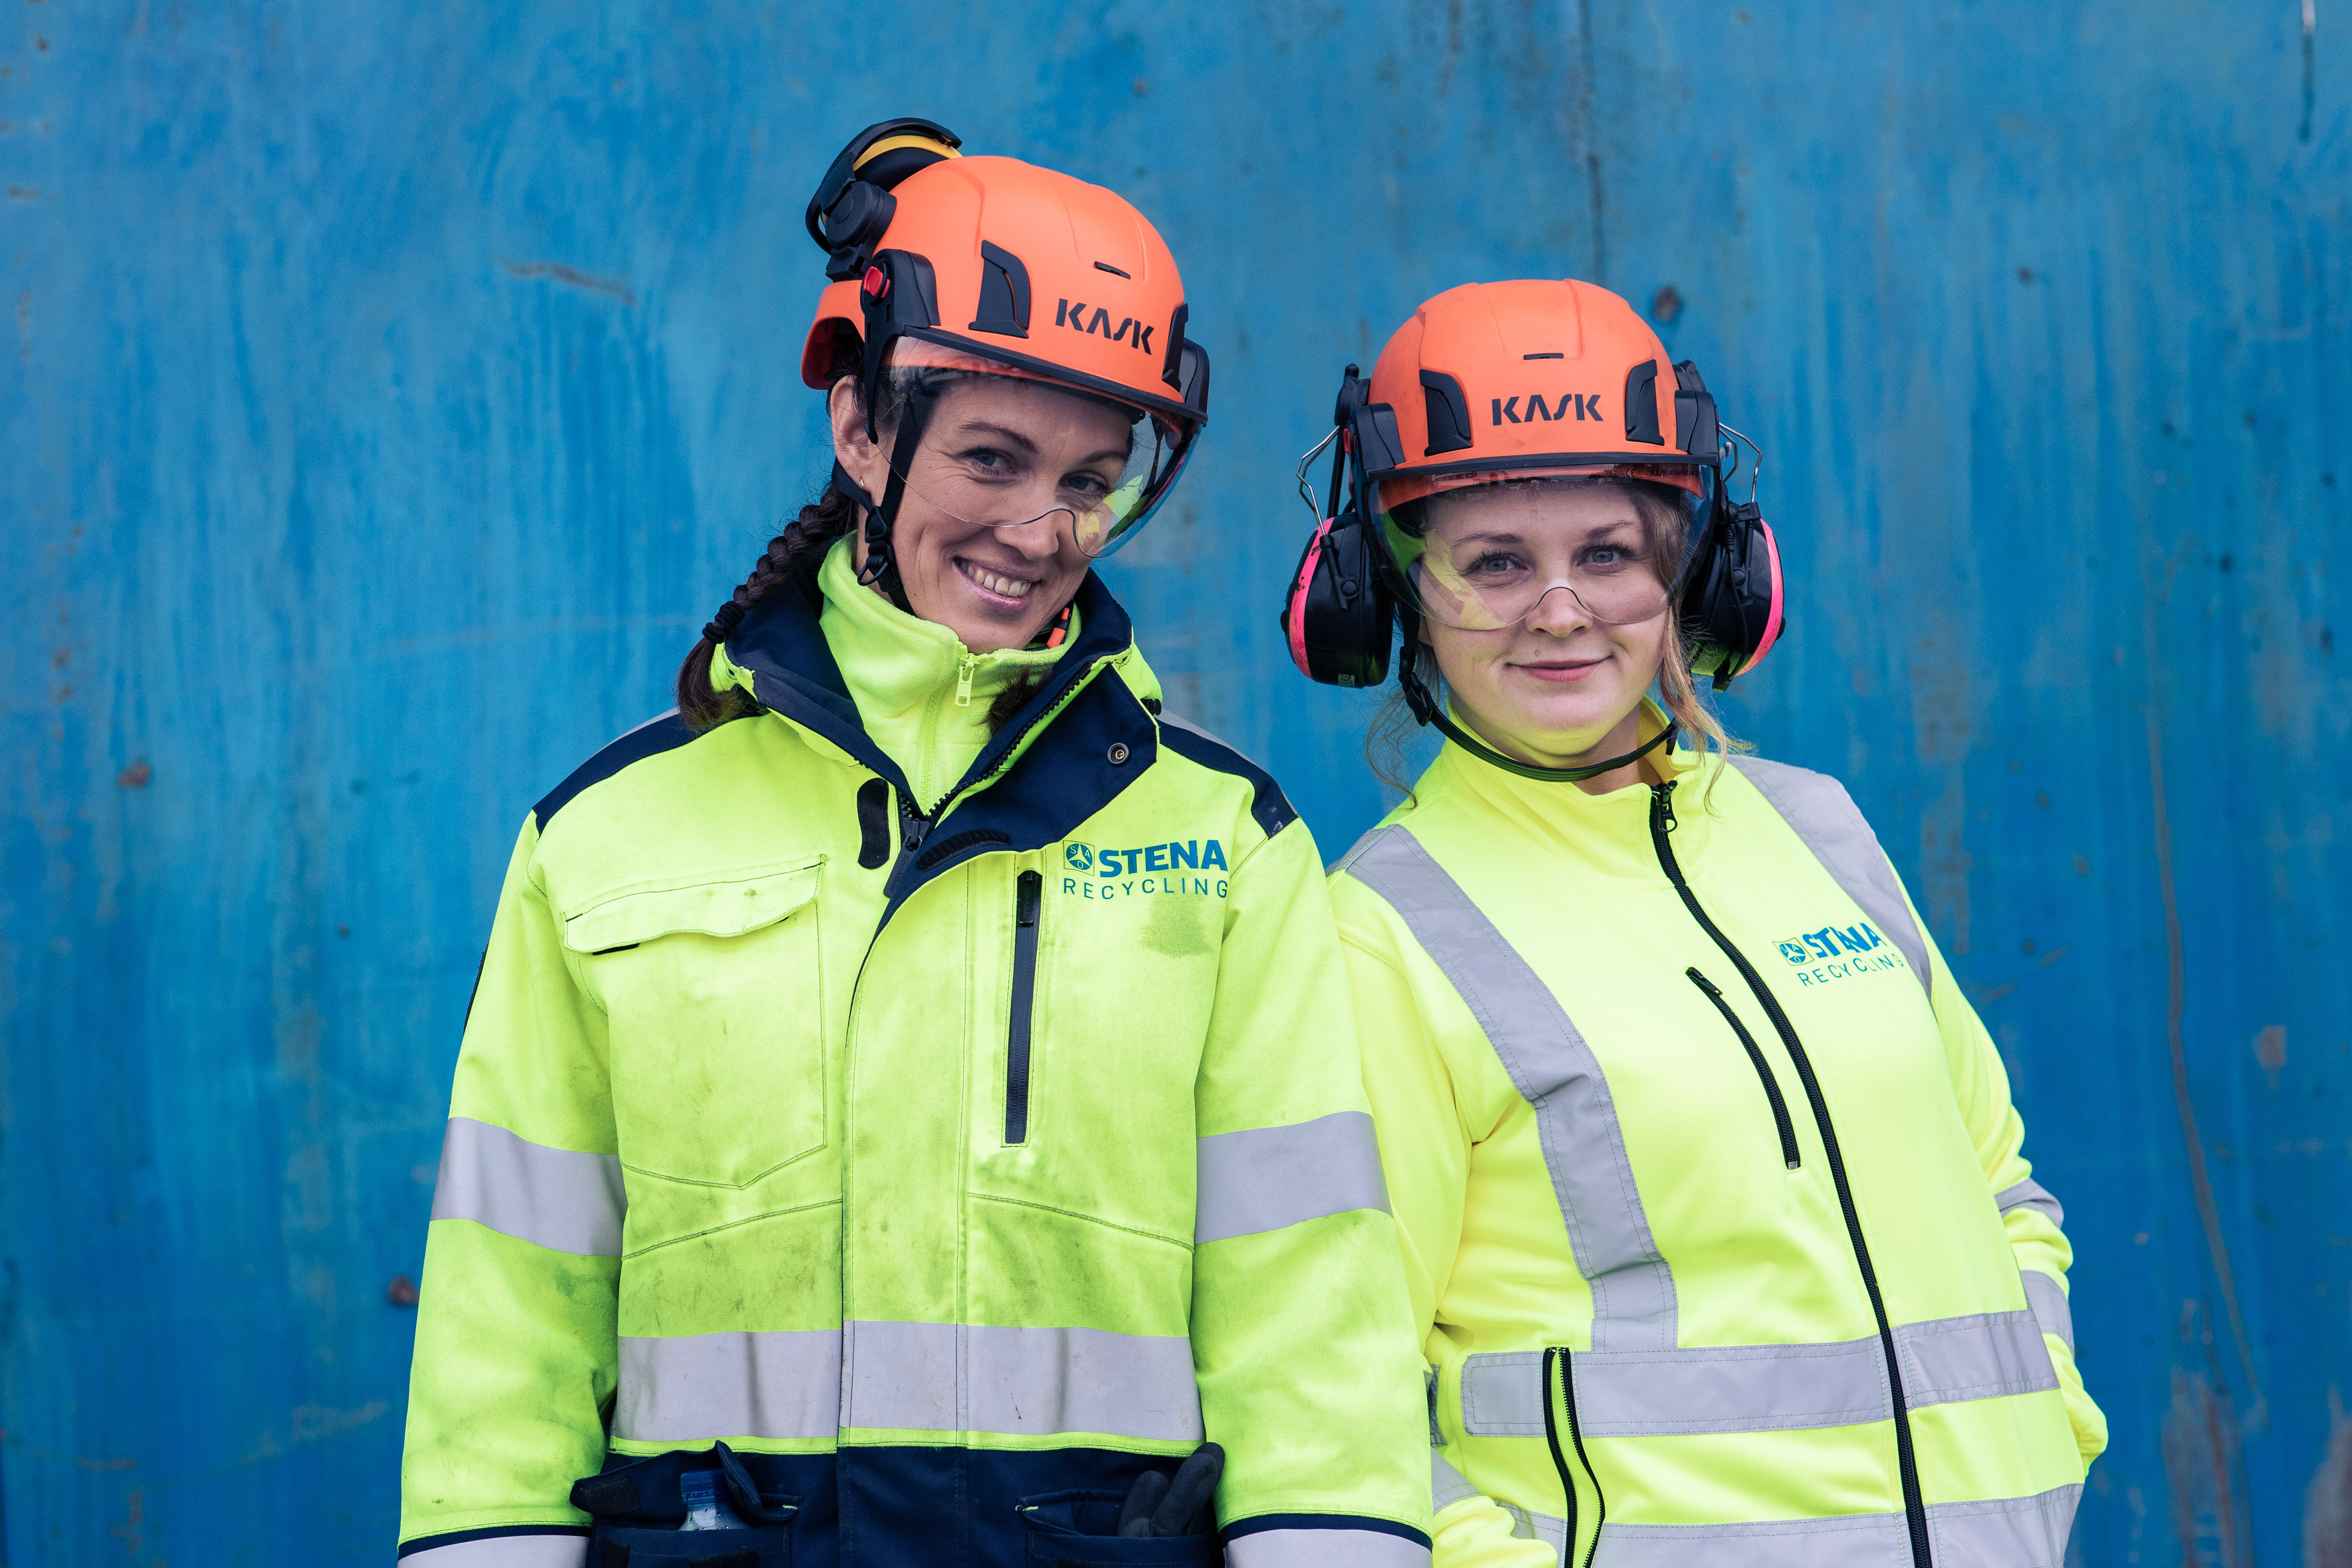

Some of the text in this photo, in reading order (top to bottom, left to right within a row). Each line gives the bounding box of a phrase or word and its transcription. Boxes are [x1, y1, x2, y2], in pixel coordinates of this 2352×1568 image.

[1055, 298, 1154, 355] KASK
[1492, 393, 1603, 426] KASK
[1098, 840, 1228, 878] STENA
[1064, 877, 1228, 900] RECYCLING
